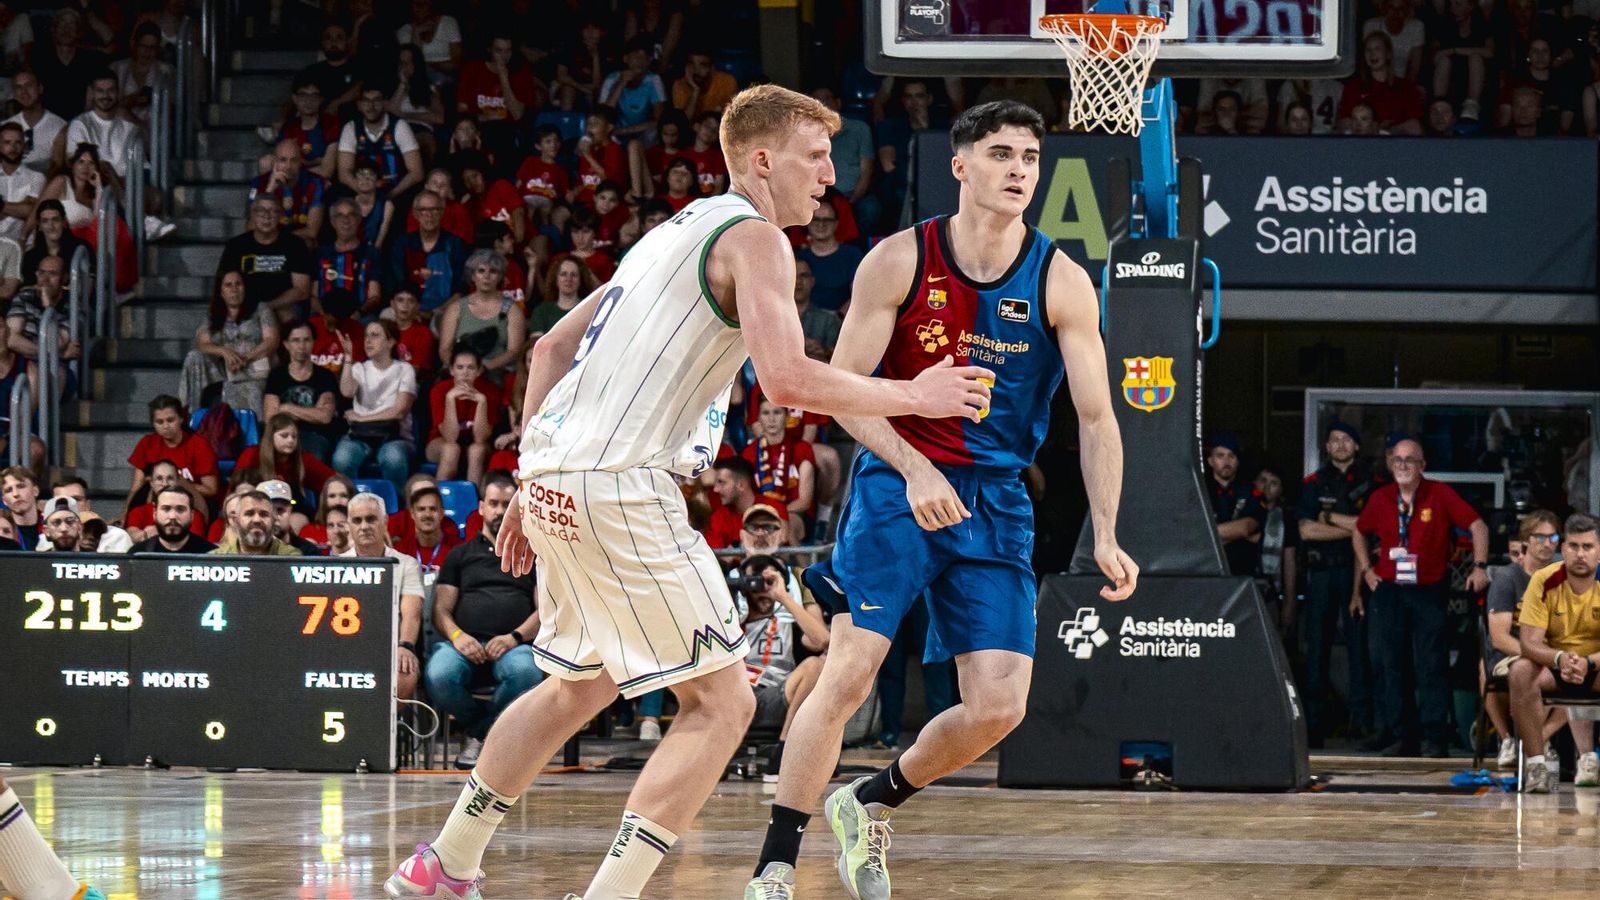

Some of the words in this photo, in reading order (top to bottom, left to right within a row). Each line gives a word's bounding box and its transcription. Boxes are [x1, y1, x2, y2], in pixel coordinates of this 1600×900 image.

[1254, 176, 1488, 214] Assistència
[1037, 158, 1109, 260] A
[1255, 217, 1417, 255] Sanitària
[1115, 262, 1186, 279] SPALDING
[955, 343, 1006, 365] Sanitària
[957, 329, 1030, 354] Assistència
[529, 482, 577, 513] COSTA
[528, 500, 546, 521] DEL
[548, 510, 579, 528] SOL
[52, 563, 121, 580] TEMPS
[168, 564, 251, 583] PERIODE
[290, 564, 386, 585] VISITANT
[23, 590, 144, 632] 2:13
[200, 599, 229, 632] 4
[297, 595, 363, 636] 78
[1119, 615, 1236, 638] Assistència
[1119, 636, 1201, 658] Sanitària
[61, 670, 131, 687] TEMPS
[141, 671, 210, 689] MORTS
[304, 671, 377, 690] FALTES
[321, 711, 346, 744] 5
[609, 821, 636, 858] UNICAJA
